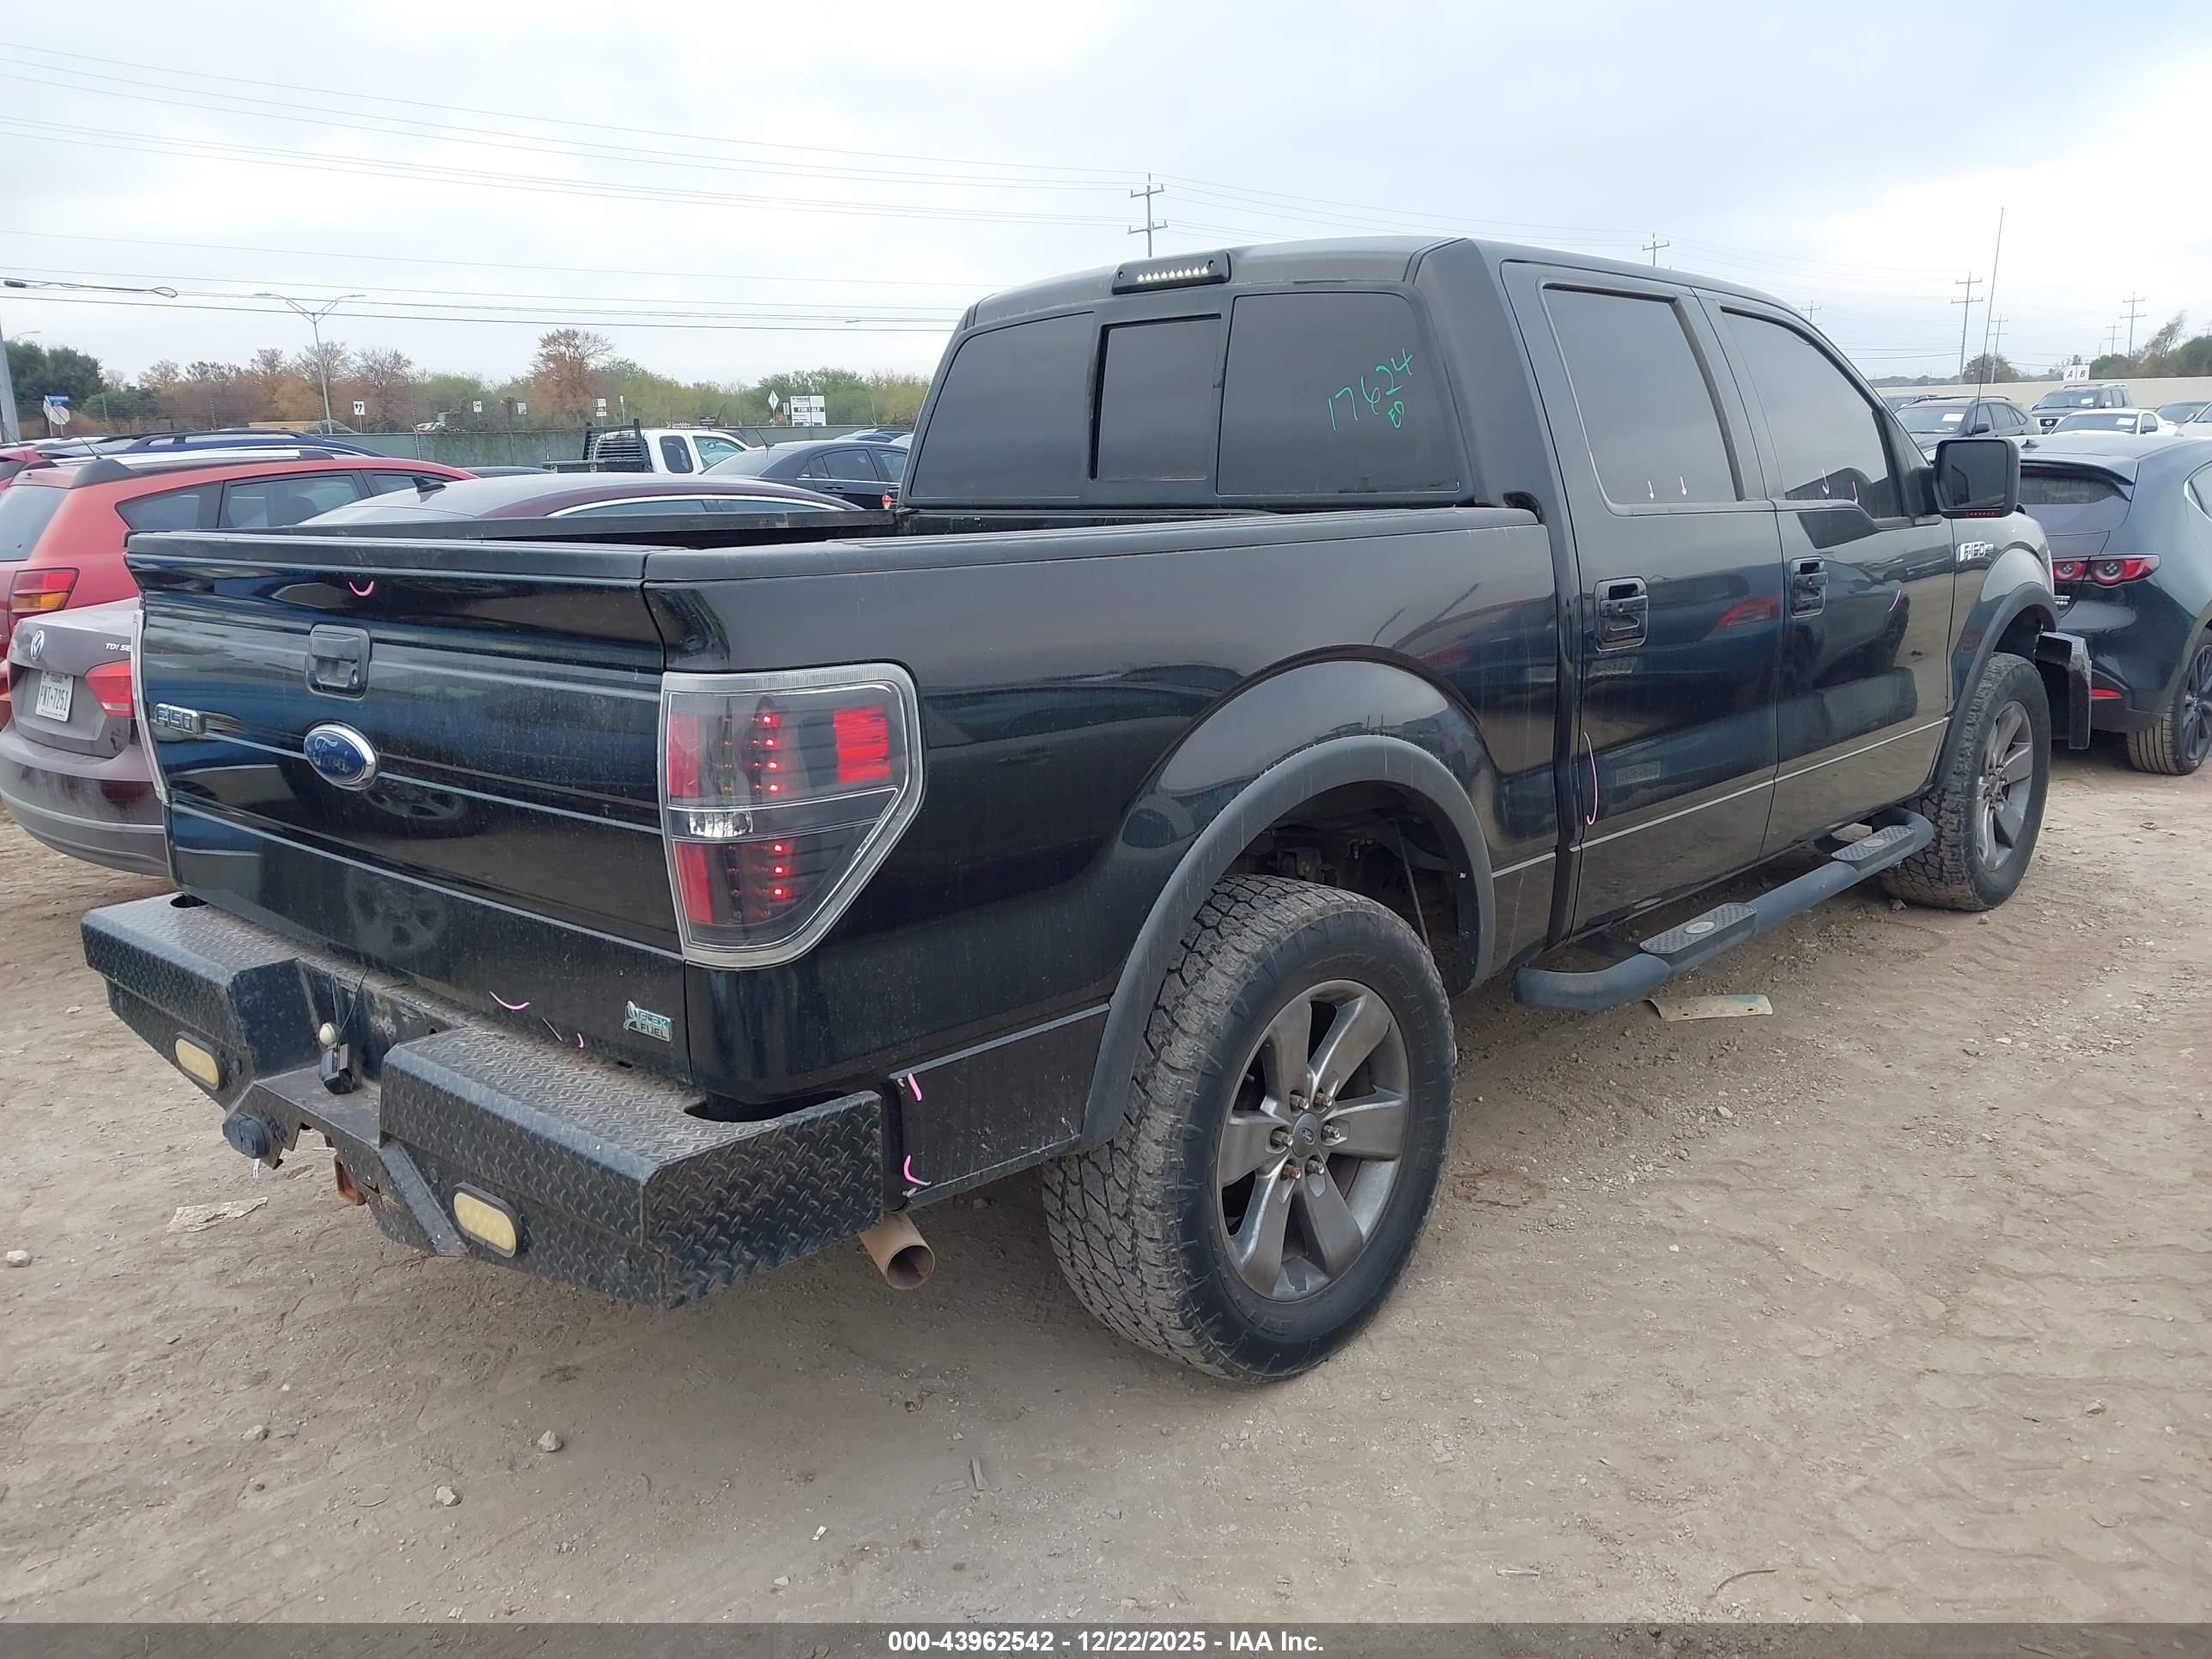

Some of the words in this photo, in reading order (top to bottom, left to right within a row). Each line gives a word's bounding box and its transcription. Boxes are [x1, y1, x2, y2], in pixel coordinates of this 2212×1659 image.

[2067, 370, 2074, 379] A
[2080, 369, 2087, 378] B
[1328, 346, 1413, 432] 17624
[106, 642, 119, 651] TDI
[640, 1012, 666, 1030] FLEX
[641, 1022, 667, 1040] FUEL
